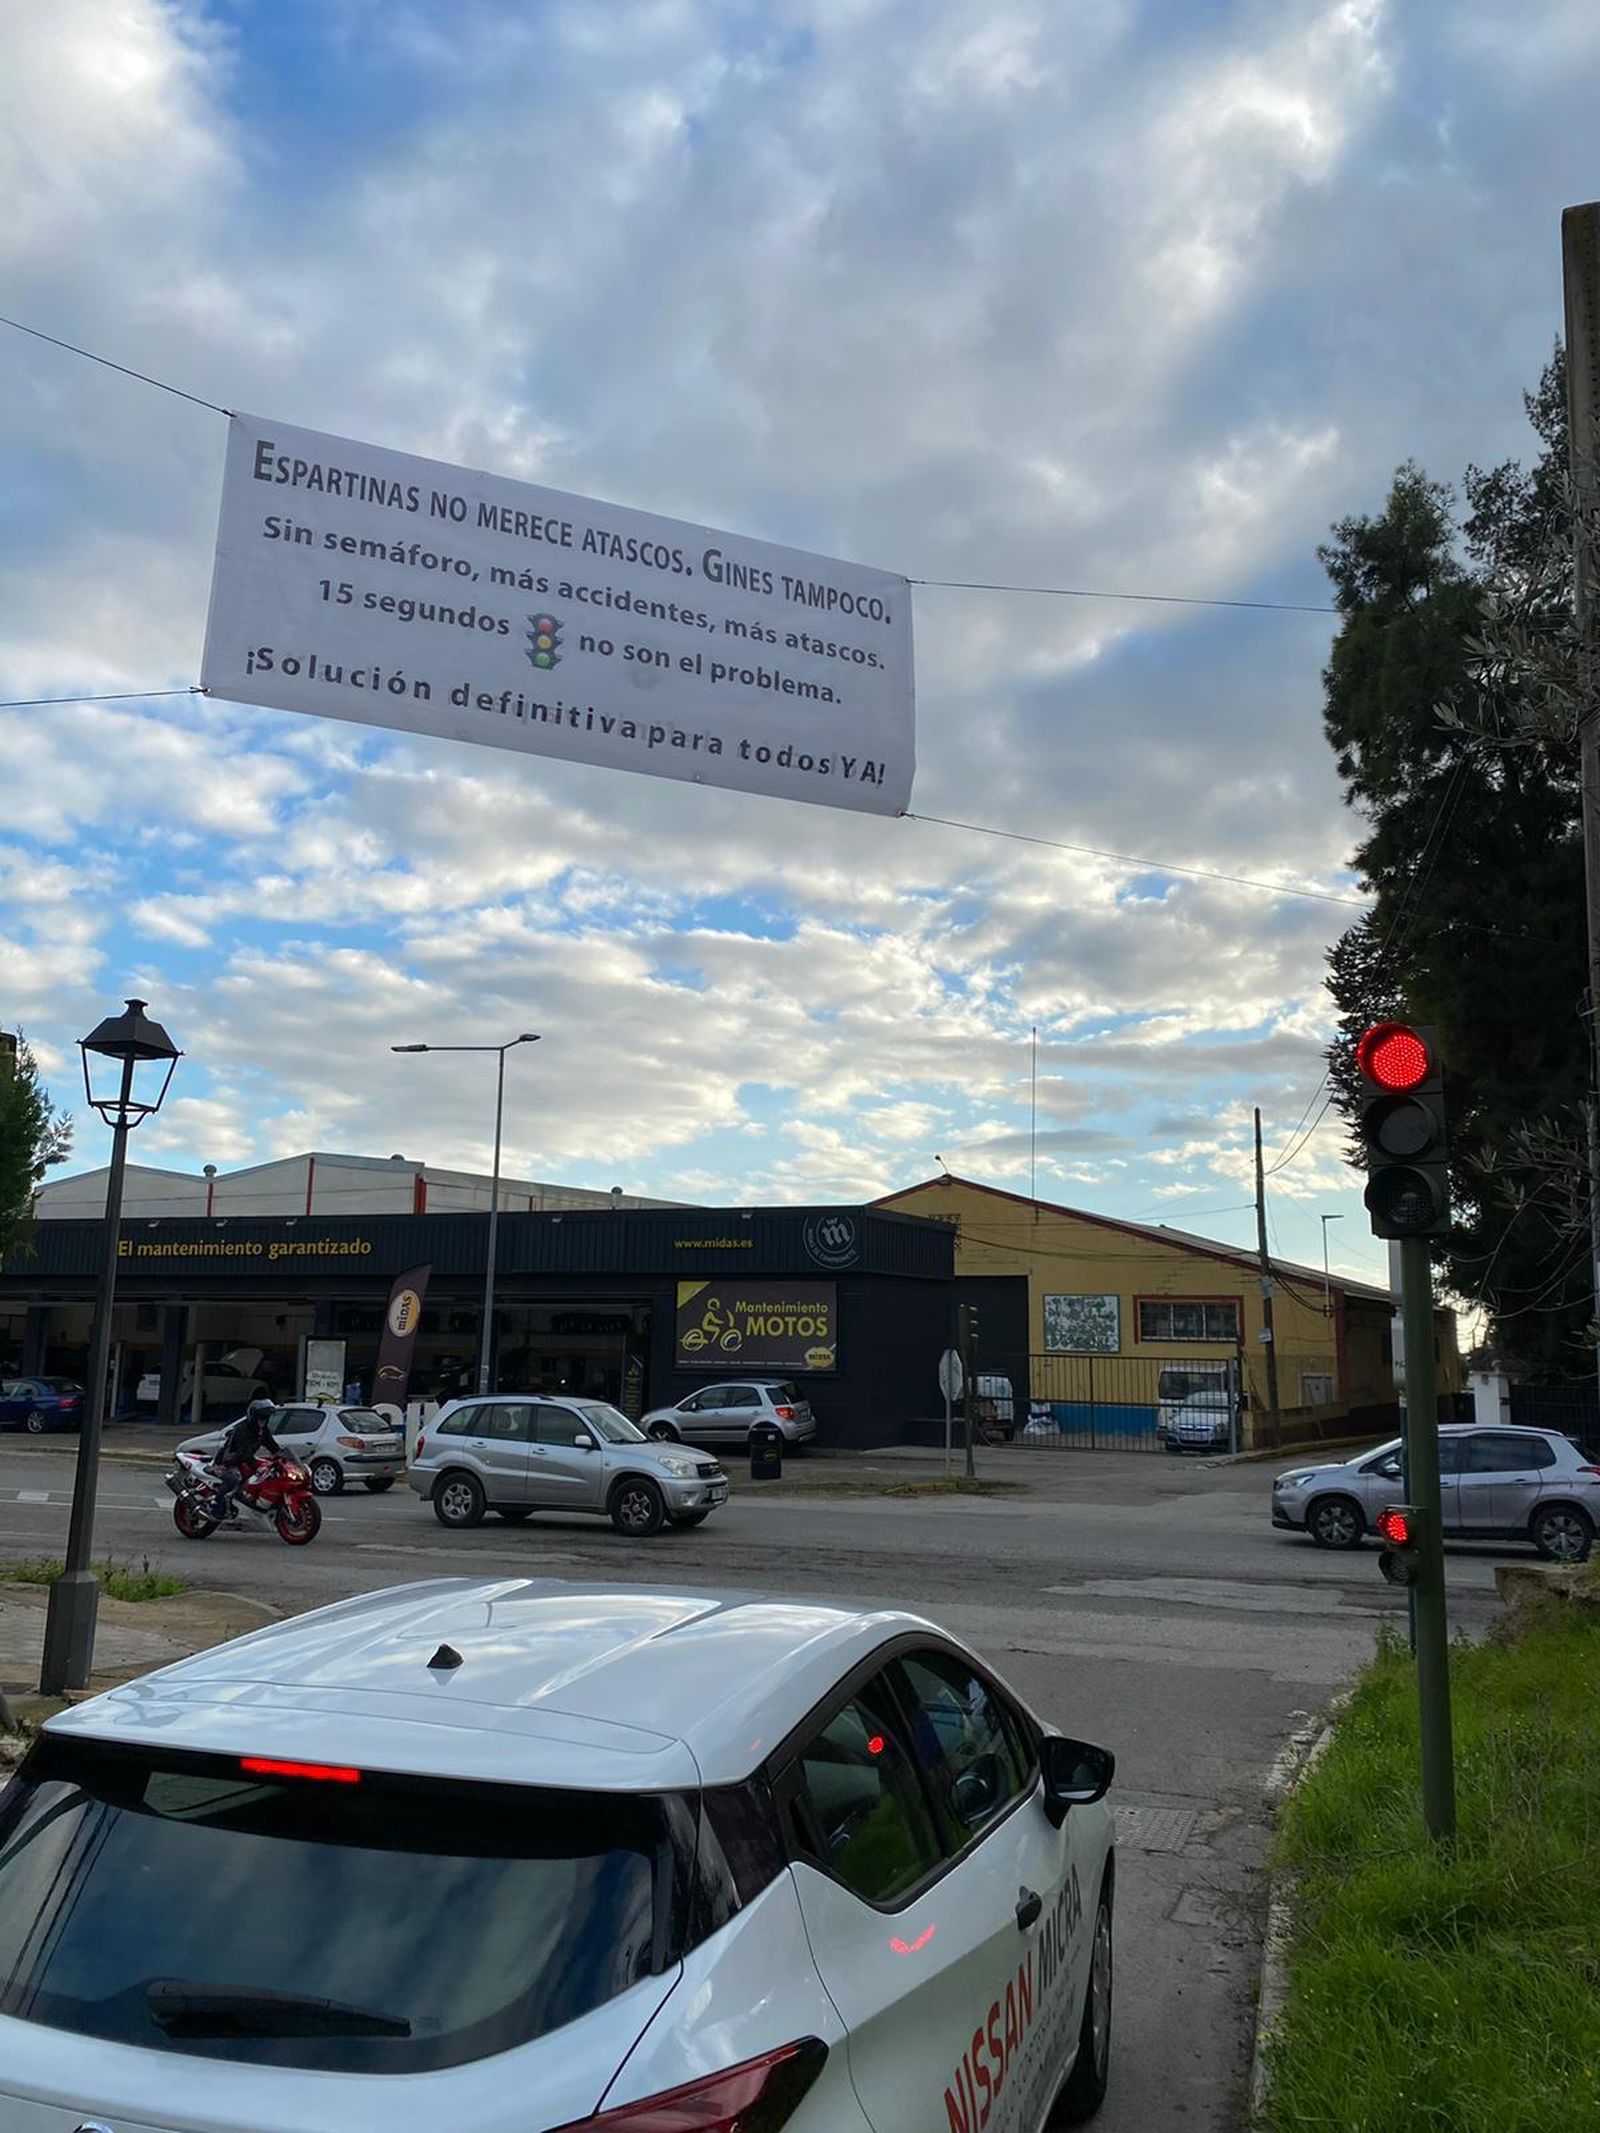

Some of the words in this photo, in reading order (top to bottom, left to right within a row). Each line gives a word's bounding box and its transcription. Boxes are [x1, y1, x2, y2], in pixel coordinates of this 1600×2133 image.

[253, 439, 420, 513] ESPARTINAS
[430, 491, 467, 522] NO
[477, 502, 572, 547] MERECE
[582, 528, 693, 577] ATASCOS.
[702, 549, 773, 596] GINES
[781, 575, 892, 625] TAMPOCO.
[263, 515, 313, 546] Sin
[323, 531, 479, 582] semáforo,
[489, 564, 549, 594] más
[558, 580, 716, 633] accidentes,
[724, 617, 777, 644] más
[785, 631, 885, 670] atascos.
[319, 579, 353, 605] 15
[364, 591, 510, 635] segundos
[580, 634, 614, 656] no
[623, 643, 670, 669] son
[679, 653, 702, 675] el
[710, 660, 842, 704] problema.
[245, 647, 431, 700] ¡Solución
[450, 683, 637, 738] definitiva
[647, 723, 722, 755] para
[740, 738, 830, 774] todos
[840, 755, 887, 787] YA!
[117, 1240, 132, 1256] El
[137, 1239, 263, 1257] mantenimiento
[268, 1238, 372, 1260] garantizado
[674, 1237, 754, 1249] www.midas.es
[735, 1300, 829, 1313] Mantenimiento
[746, 1316, 828, 1338] MOTOS
[944, 1951, 1032, 2133] NISSAN
[1037, 1863, 1082, 2007] MICRA
